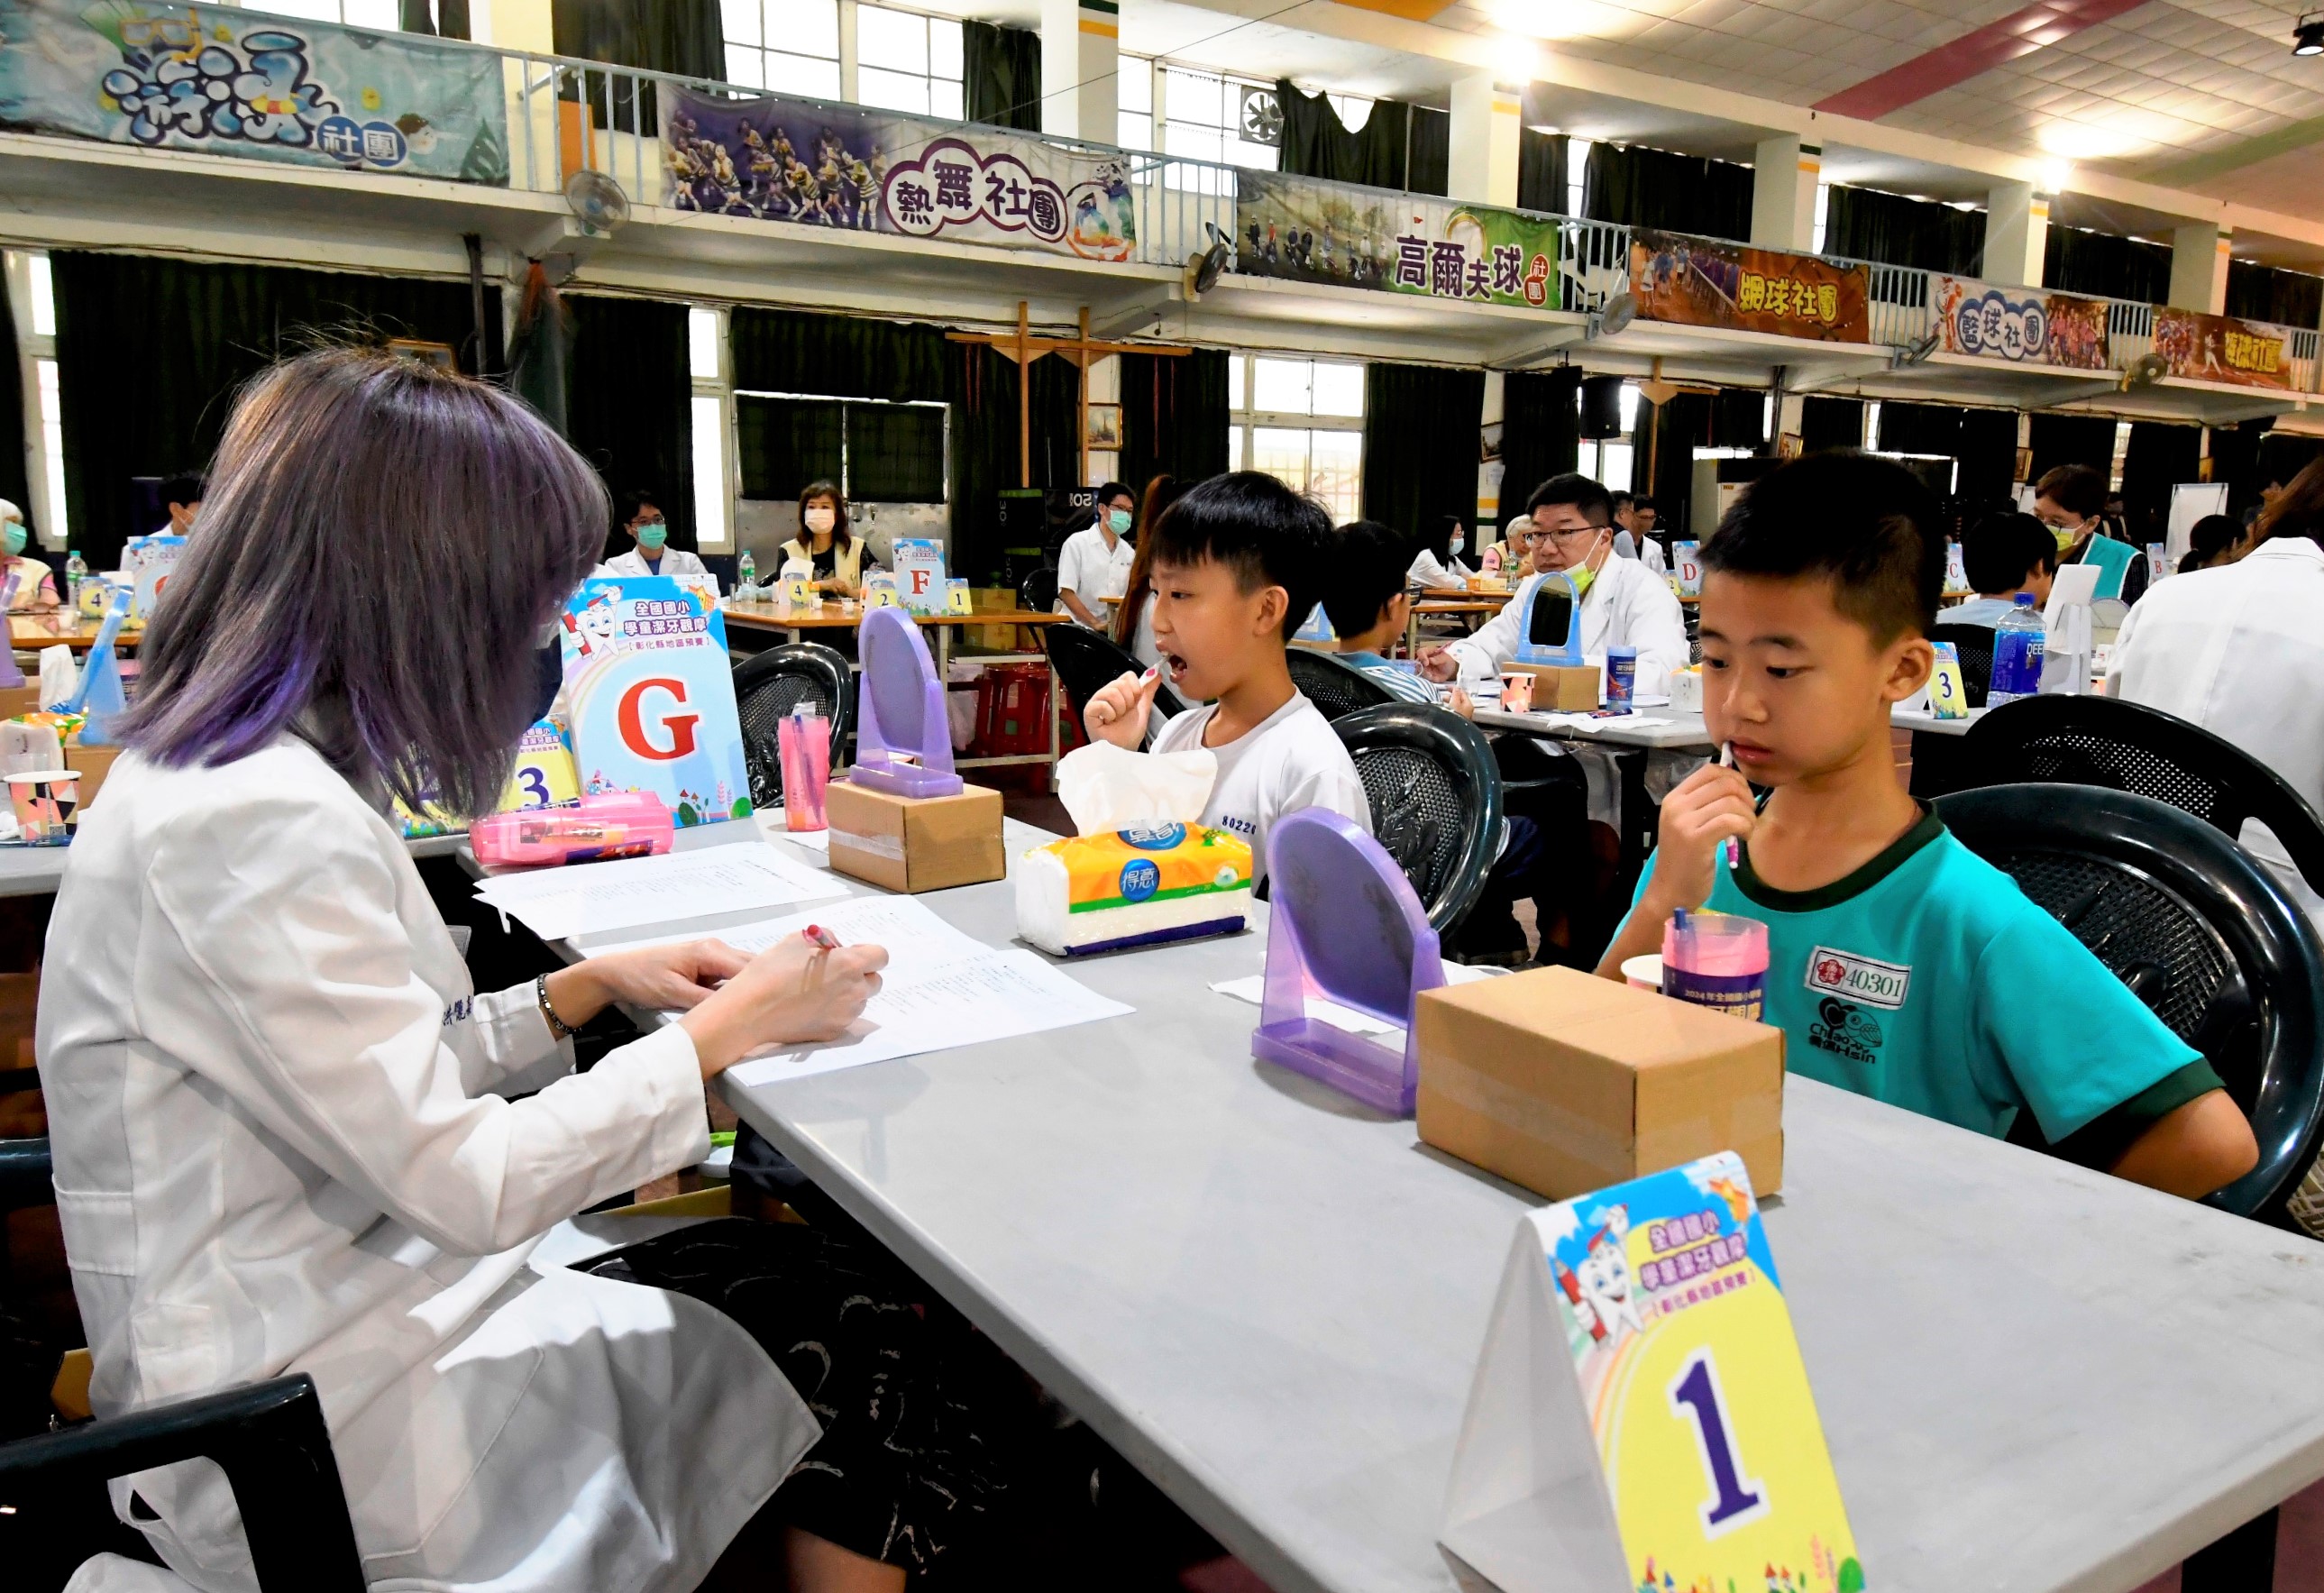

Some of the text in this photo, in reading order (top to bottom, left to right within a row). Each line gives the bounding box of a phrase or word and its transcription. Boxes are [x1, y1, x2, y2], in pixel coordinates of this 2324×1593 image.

[321, 124, 400, 162] 社團
[895, 158, 1061, 235] 熱舞社團
[1395, 233, 1523, 300] 高爾夫球
[1528, 261, 1547, 300] 社團
[1739, 270, 1838, 323] 網球社團
[910, 570, 930, 595] F
[1682, 563, 1697, 581] D
[1949, 563, 1959, 579] C
[90, 592, 102, 608] 4
[793, 584, 802, 597] 4
[880, 593, 889, 606] 2
[956, 592, 962, 606] 1
[635, 599, 691, 617] 全國國小
[623, 617, 709, 637] 學童潔牙觀摩
[2027, 643, 2045, 655] DEE
[1938, 671, 1953, 699] 3
[618, 677, 700, 761] G
[517, 766, 549, 808] 3
[1121, 866, 1156, 893] 得意
[1845, 968, 1902, 998] 40301
[1675, 1359, 1760, 1526] 1
